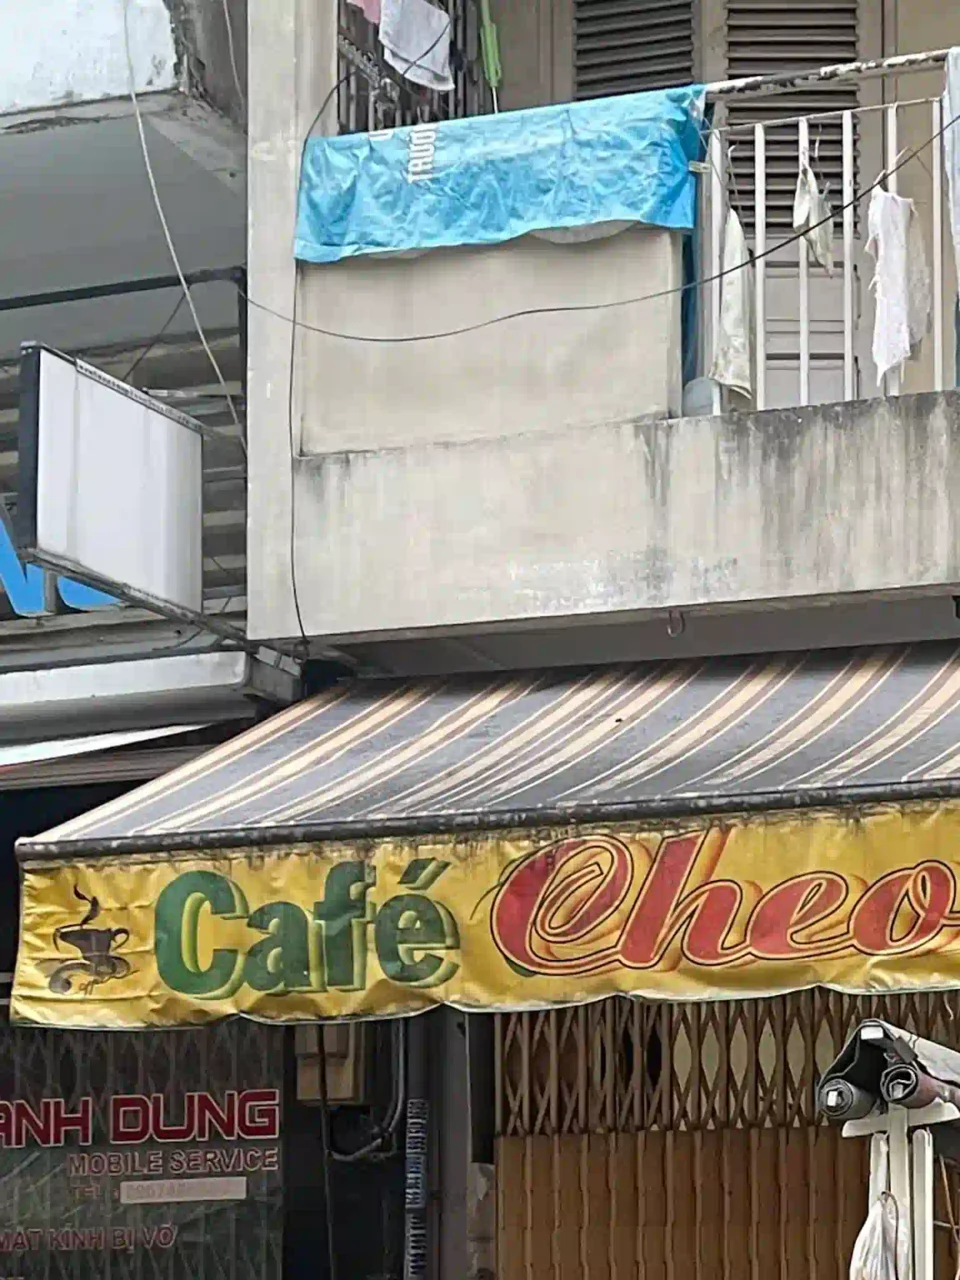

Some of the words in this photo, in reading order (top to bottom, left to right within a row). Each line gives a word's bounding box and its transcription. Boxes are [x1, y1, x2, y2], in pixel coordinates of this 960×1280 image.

[155, 857, 459, 999] Café
[109, 1088, 280, 1144] DUNG
[68, 1151, 164, 1178] MOBILE
[169, 1147, 280, 1174] SERVICE
